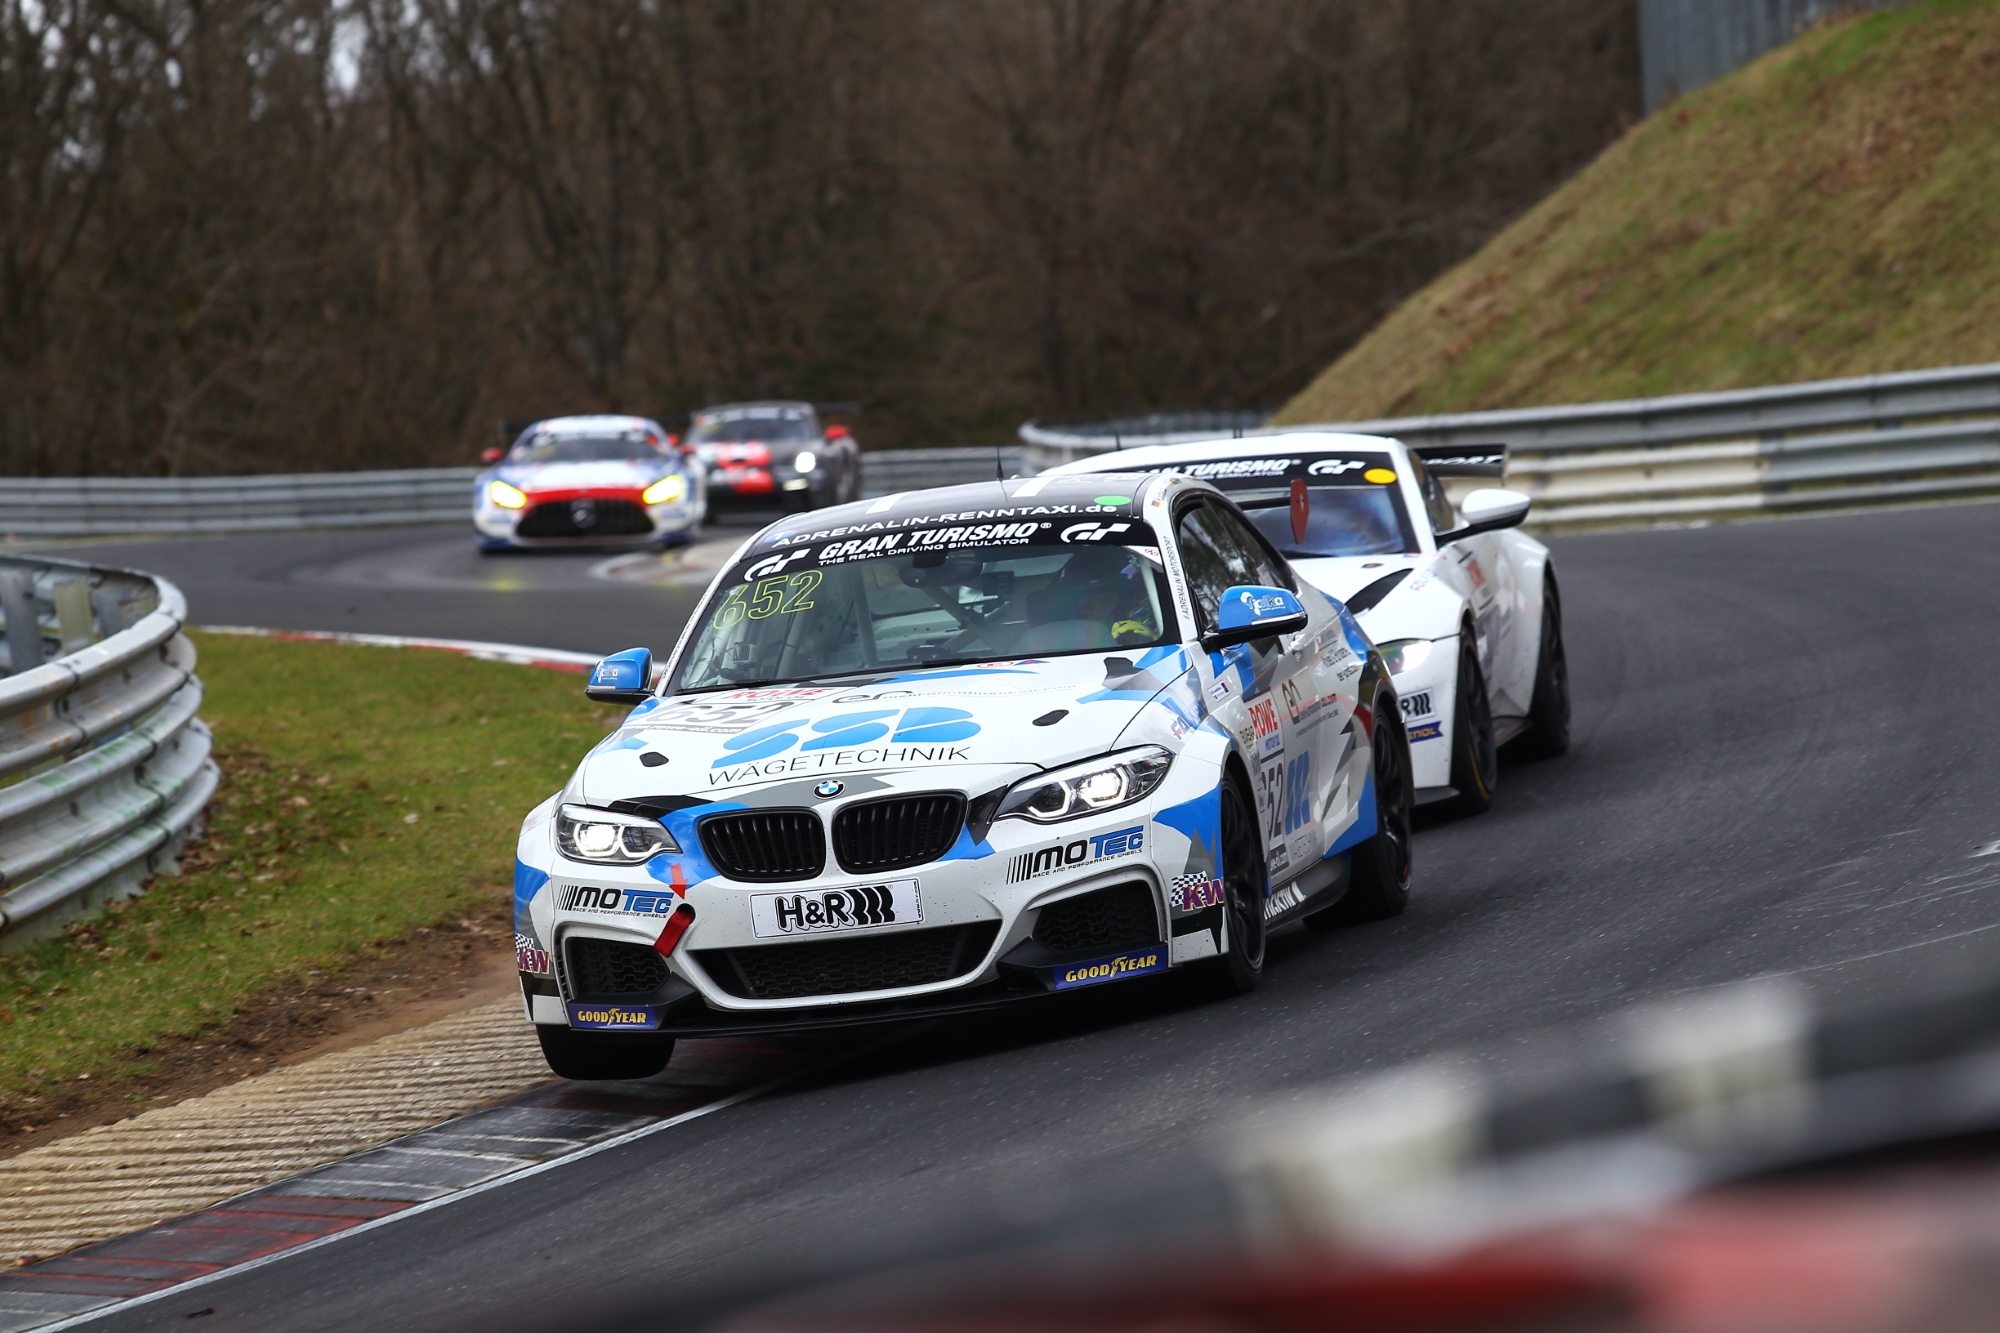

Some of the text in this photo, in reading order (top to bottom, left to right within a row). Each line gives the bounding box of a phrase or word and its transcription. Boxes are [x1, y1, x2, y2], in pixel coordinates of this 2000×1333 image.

[774, 504, 1118, 548] ADRENALIN-RENNTAXI.de
[818, 534, 898, 560] GRAN
[818, 537, 1029, 567] THE REAL DRIVING SIMULATOR
[713, 569, 823, 631] 652
[645, 701, 795, 725] 652
[1248, 699, 1278, 739] ROWE
[708, 746, 971, 786] WÄGETECHNIK
[1032, 849, 1143, 879] RACE AND PERFORMANCE WHEELS
[1181, 878, 1224, 912] KW
[600, 909, 641, 917] PERFORMANCE
[775, 890, 855, 932] H&R
[1065, 954, 1158, 983] GOODYEAR
[577, 1008, 647, 1026] GOODYEAR
